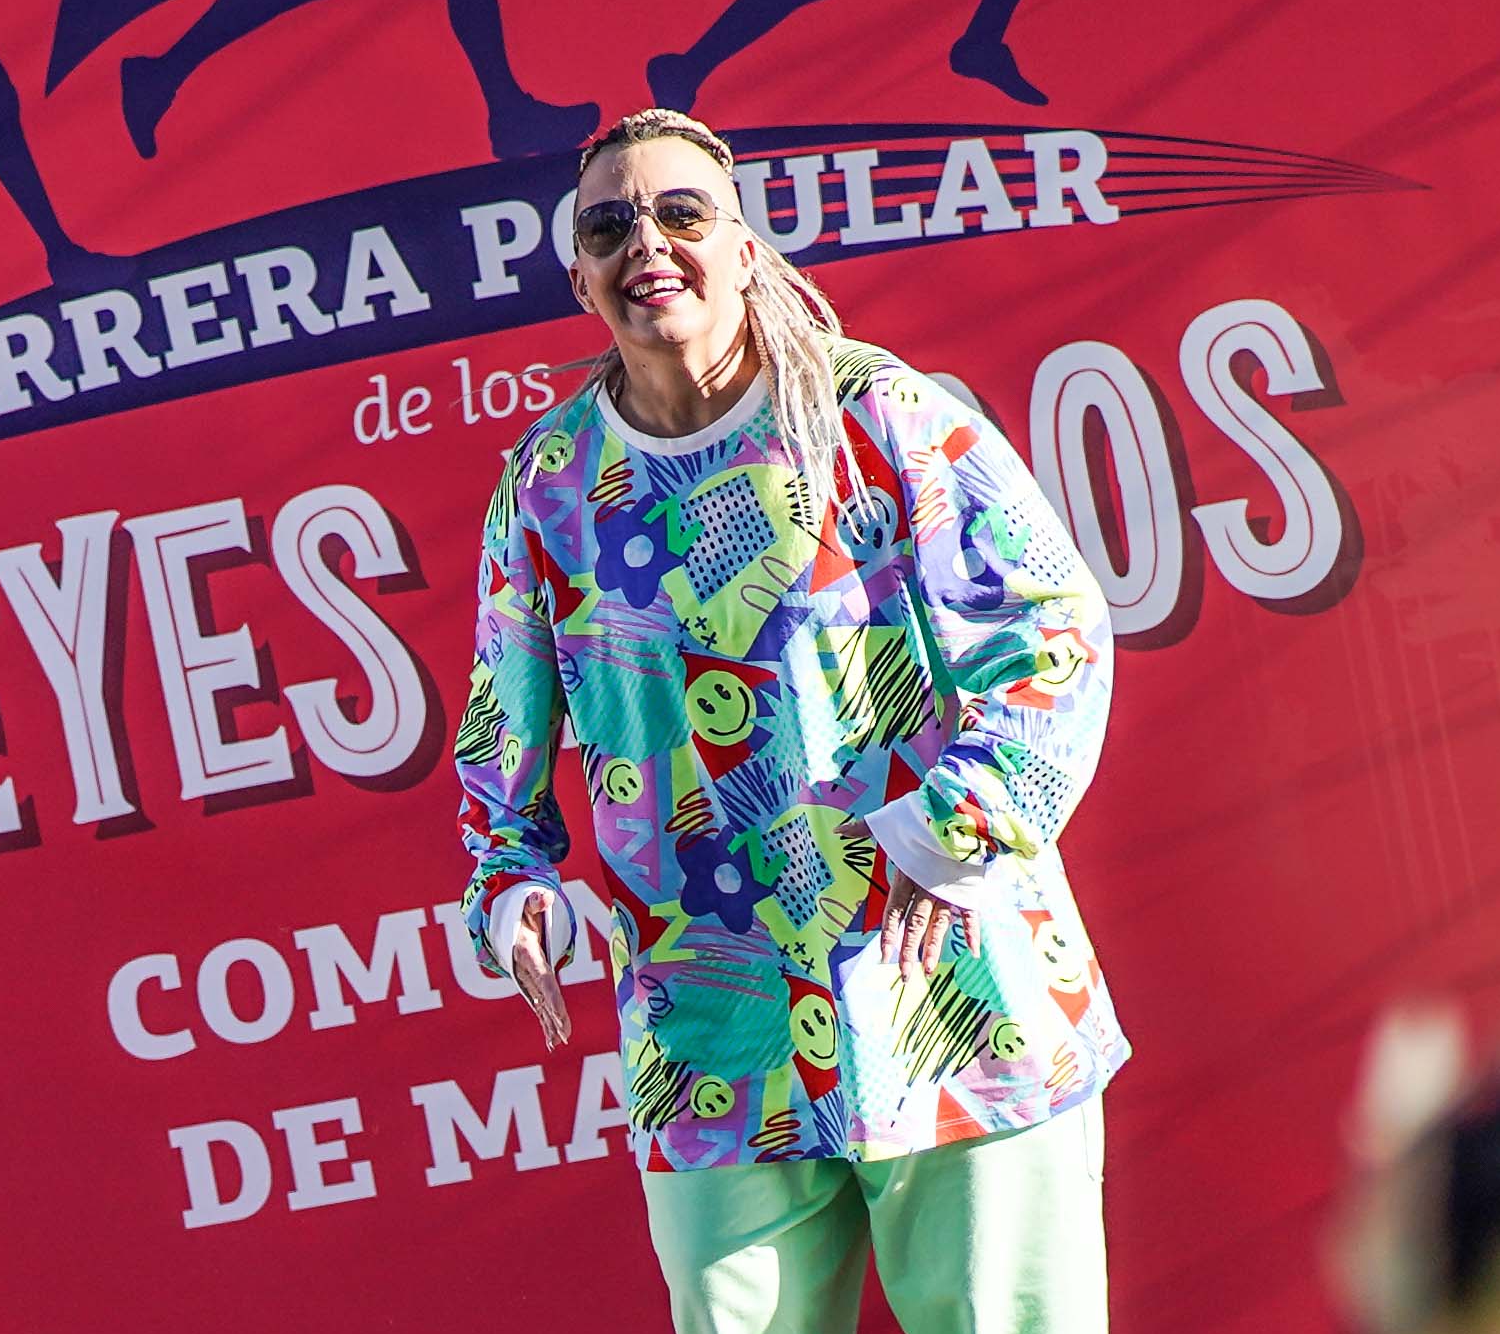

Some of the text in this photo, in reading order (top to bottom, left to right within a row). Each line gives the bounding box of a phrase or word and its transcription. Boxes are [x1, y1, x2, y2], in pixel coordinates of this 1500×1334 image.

[460, 130, 1120, 301] PULAR
[353, 357, 556, 445] de los
[106, 878, 614, 1061] COMUN
[168, 1096, 379, 1230] DE
